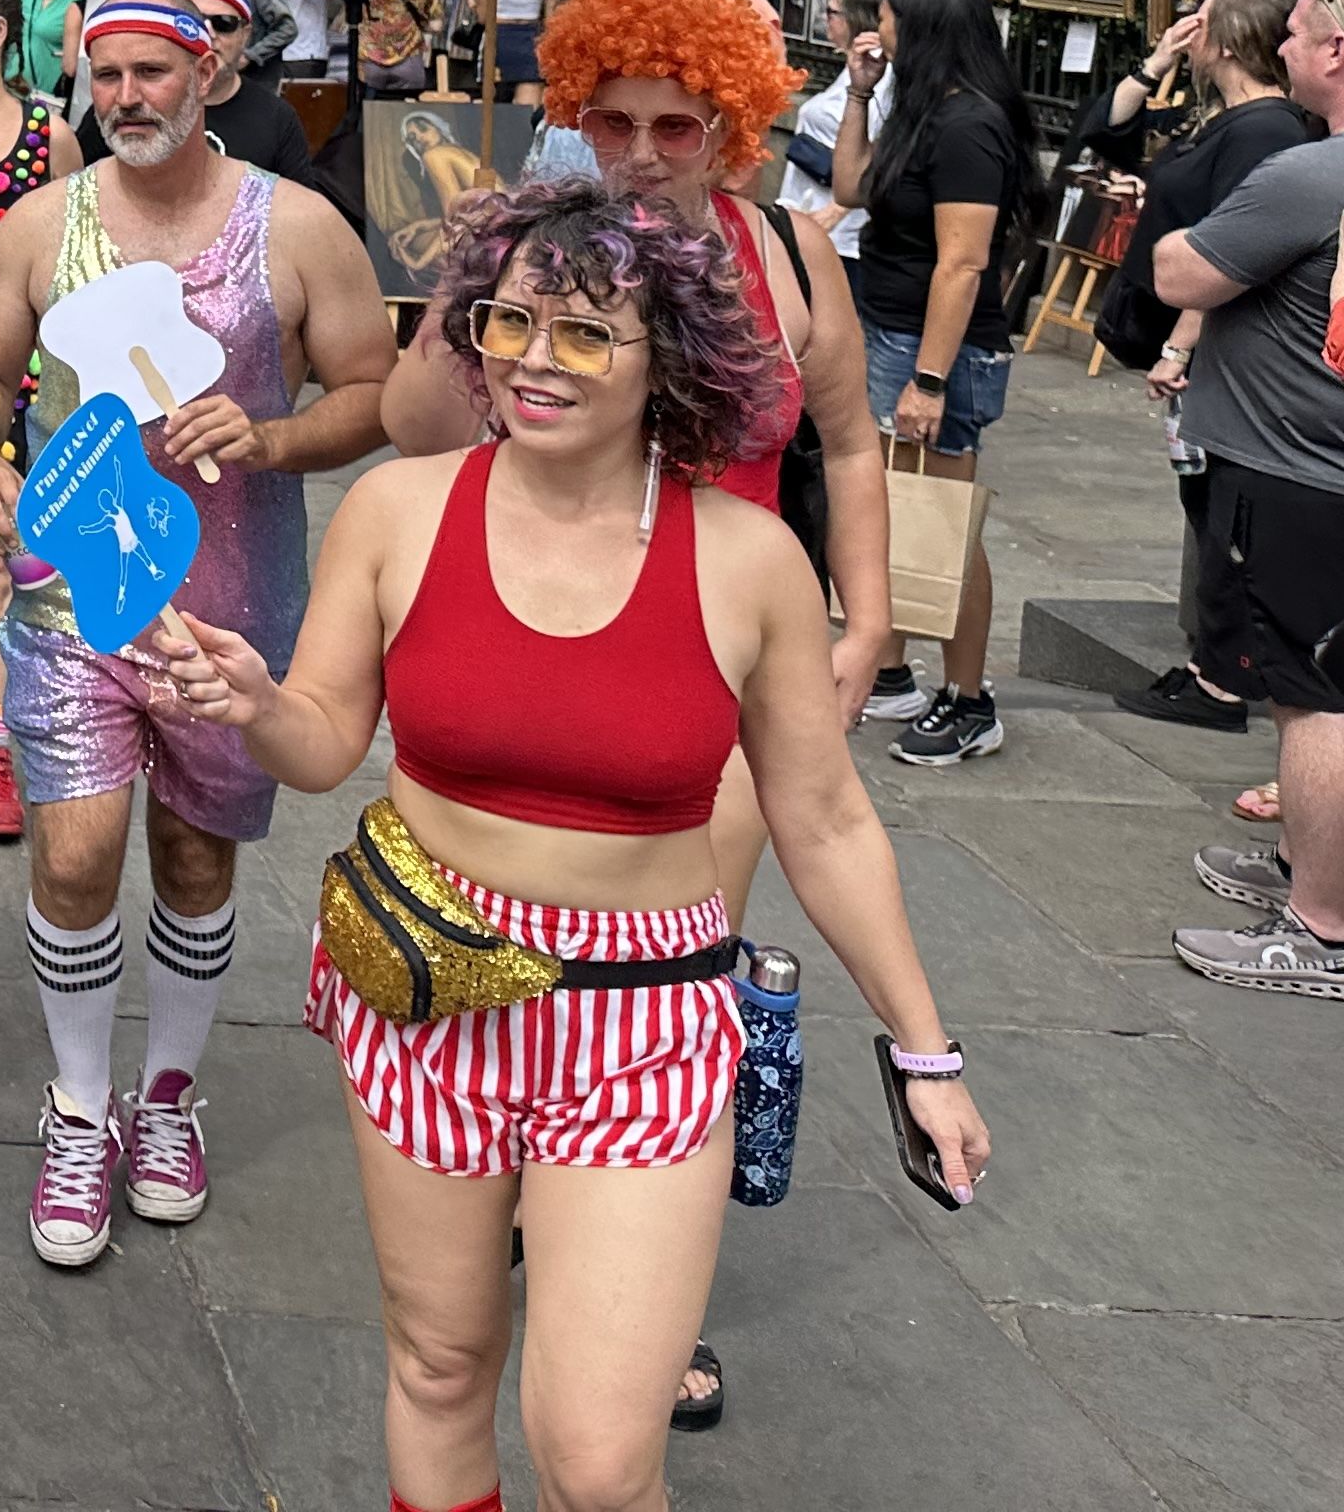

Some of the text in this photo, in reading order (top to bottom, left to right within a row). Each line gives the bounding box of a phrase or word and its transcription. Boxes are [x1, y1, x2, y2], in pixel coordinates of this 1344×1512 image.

[31, 415, 125, 538] Richard Simmons
[34, 411, 99, 498] I'm a FAN of
